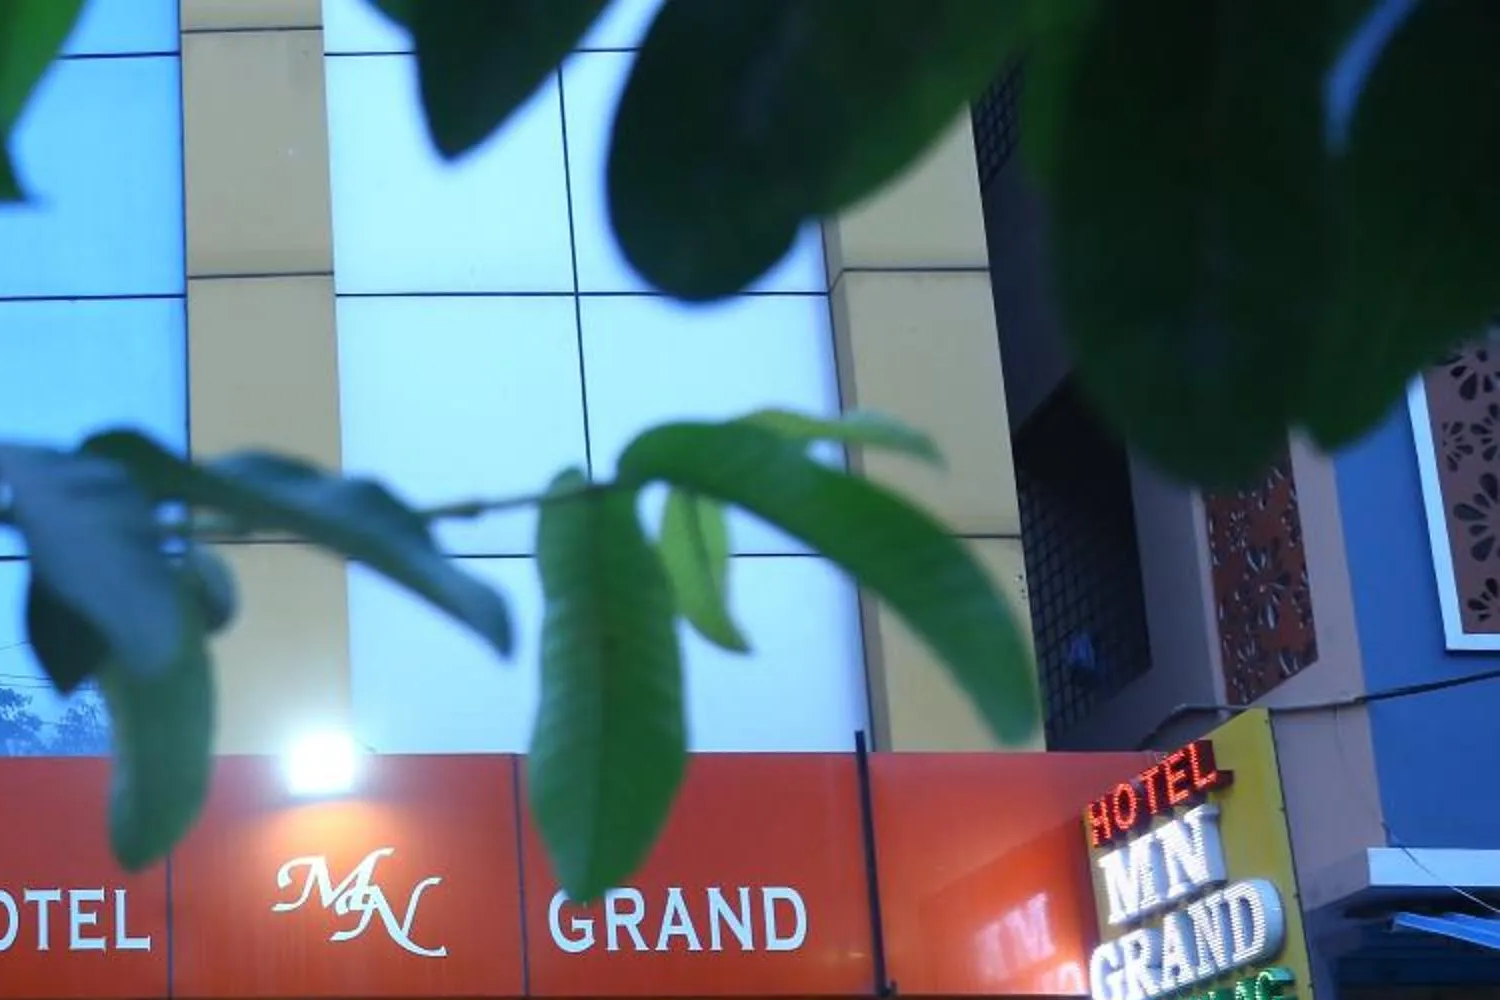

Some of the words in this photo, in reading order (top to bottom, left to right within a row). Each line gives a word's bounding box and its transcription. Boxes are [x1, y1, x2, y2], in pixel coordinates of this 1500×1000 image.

[1085, 741, 1219, 847] HOTEL
[1097, 804, 1221, 925] MN
[548, 886, 808, 953] GRAND
